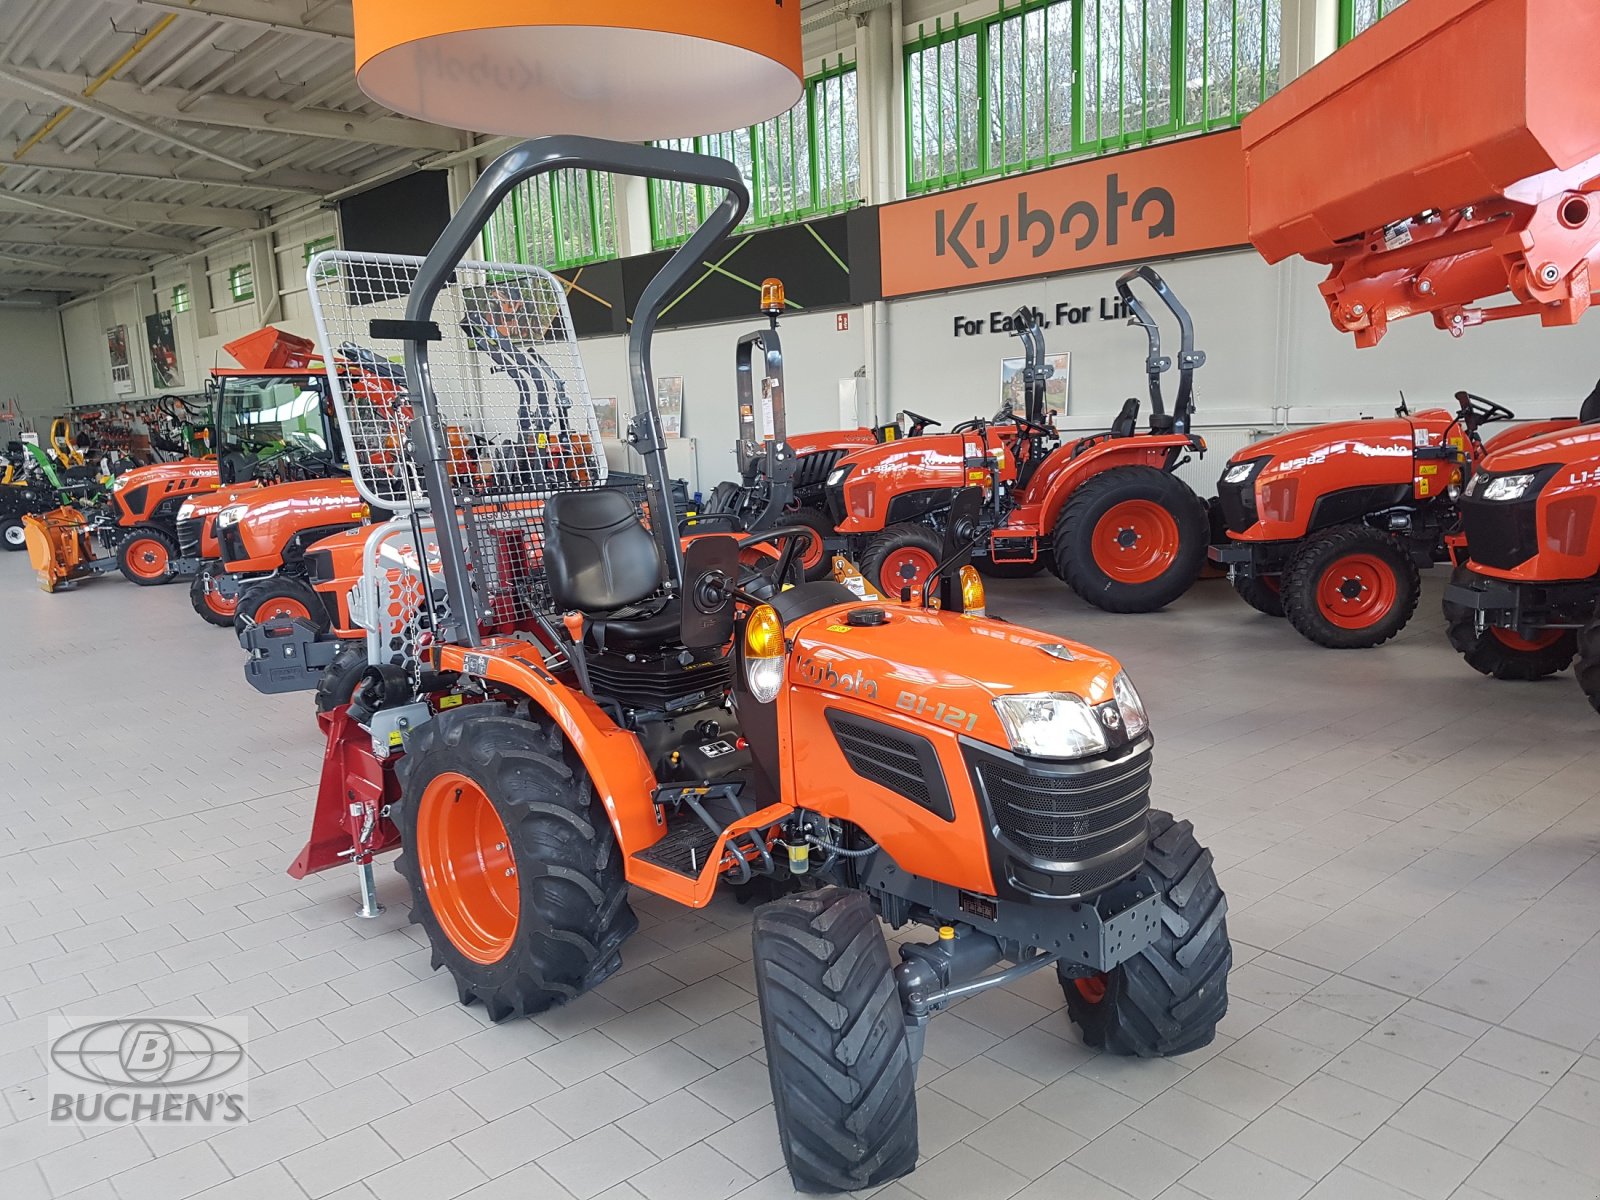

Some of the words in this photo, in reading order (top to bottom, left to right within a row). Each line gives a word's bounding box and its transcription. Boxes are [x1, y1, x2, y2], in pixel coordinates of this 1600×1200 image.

[935, 173, 1175, 268] Kubota
[954, 315, 983, 337] For
[990, 306, 1050, 334] Eah,
[1056, 303, 1091, 326] For
[797, 655, 878, 699] Kubota
[896, 691, 978, 731] B1-121
